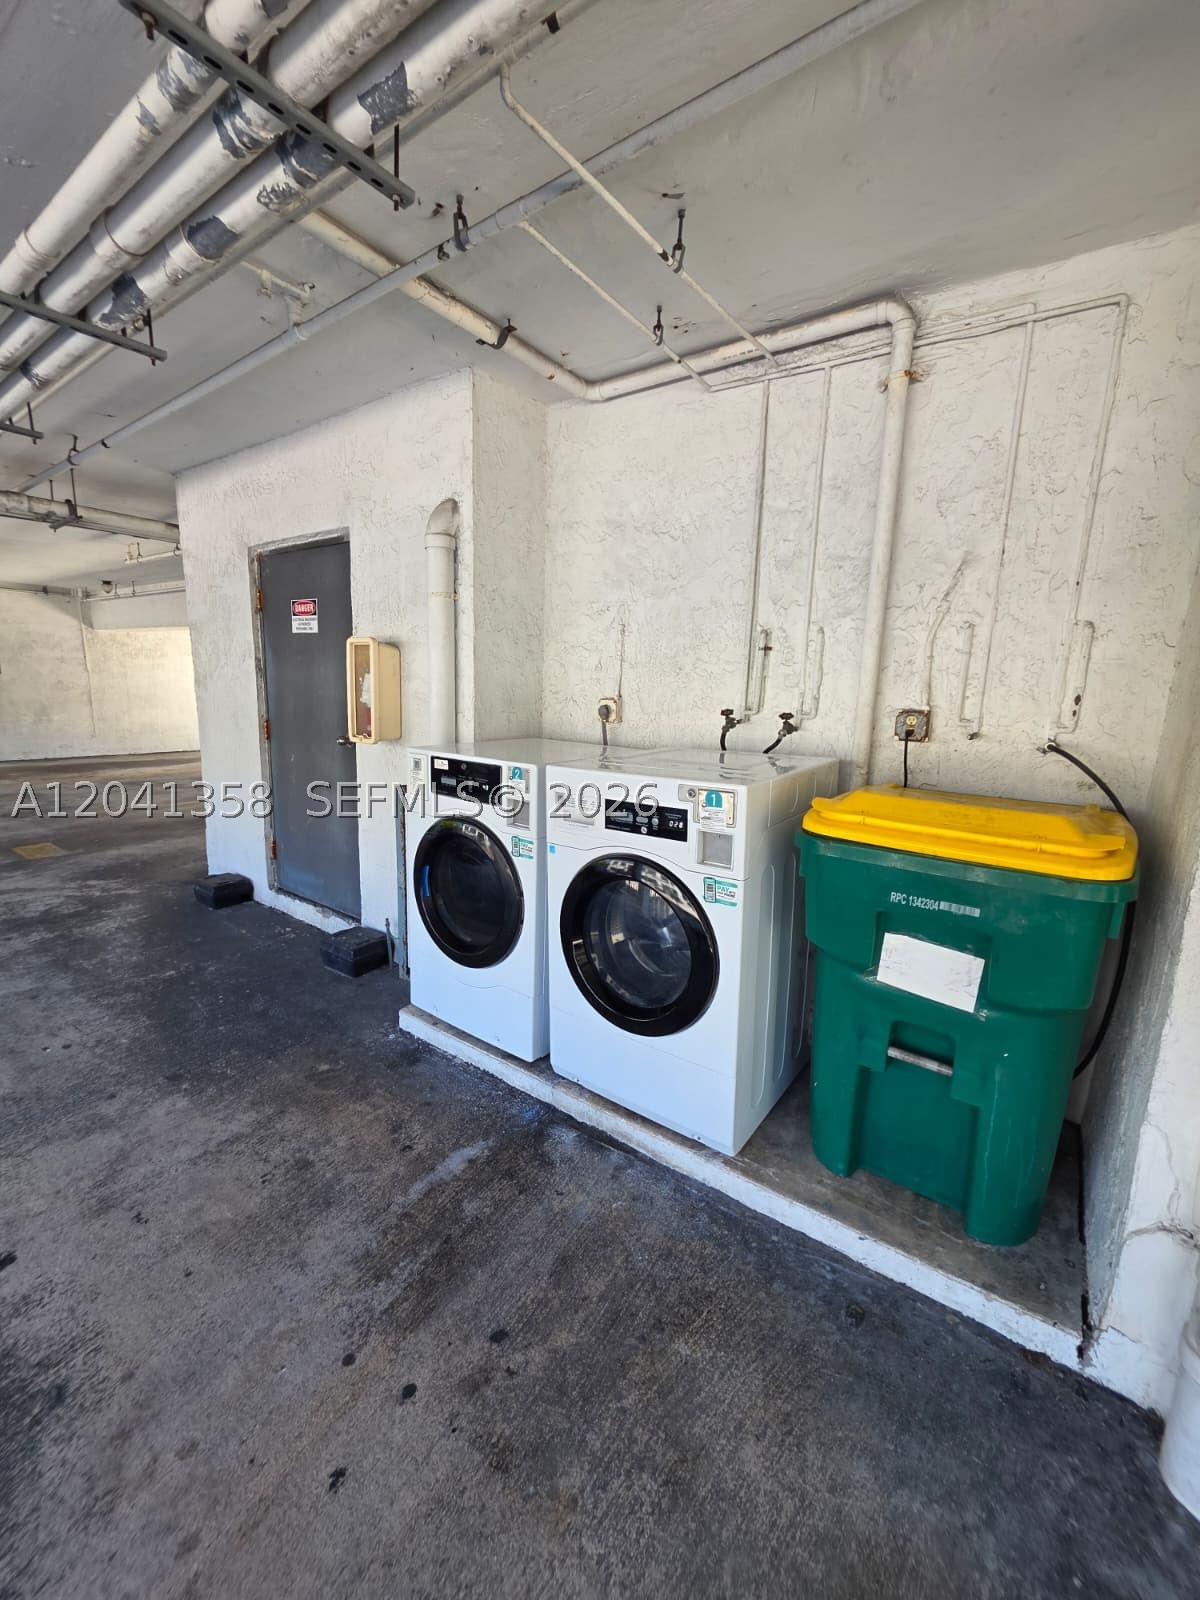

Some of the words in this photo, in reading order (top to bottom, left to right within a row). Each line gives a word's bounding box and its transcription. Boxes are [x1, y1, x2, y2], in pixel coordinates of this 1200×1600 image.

[515, 769, 520, 778] 2
[711, 793, 716, 806] 1
[716, 885, 730, 893] PAY
[890, 891, 906, 905] RPC
[908, 896, 939, 911] 1342304
